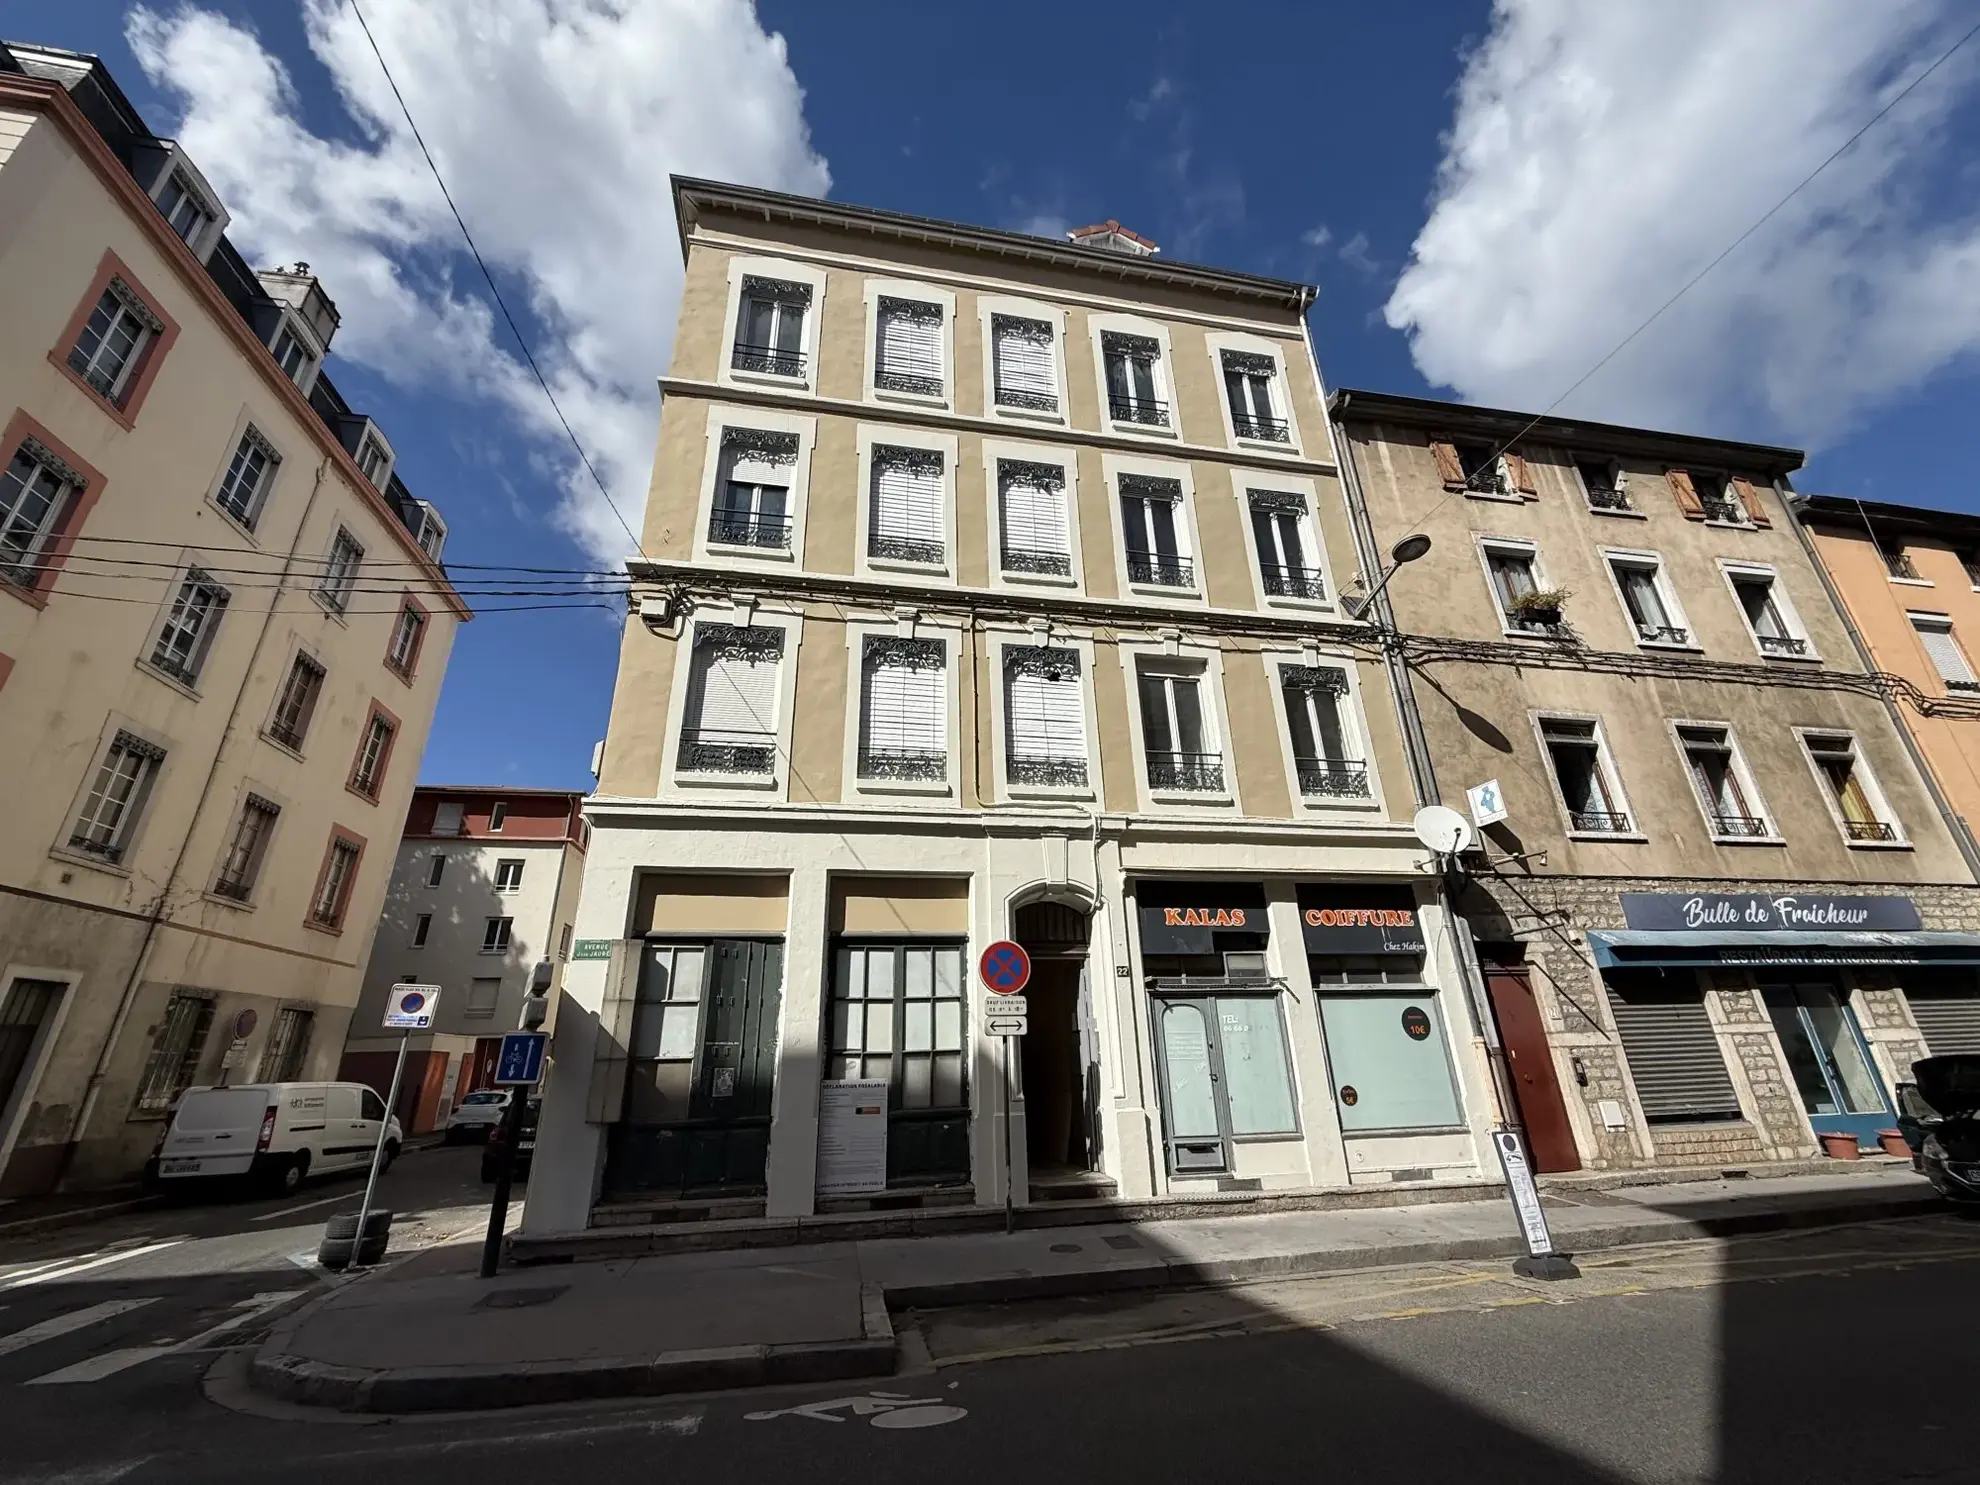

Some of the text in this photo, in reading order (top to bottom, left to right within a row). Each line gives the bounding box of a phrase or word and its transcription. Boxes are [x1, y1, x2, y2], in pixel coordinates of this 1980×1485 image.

[1164, 908, 1246, 926] KALAS
[1306, 909, 1414, 927] COIFFURE
[1682, 898, 1740, 928] Bulle
[1745, 900, 1769, 923] de
[1384, 941, 1426, 952] Chez Hakim
[1117, 967, 1128, 975] 22
[1410, 1025, 1425, 1034] 10€
